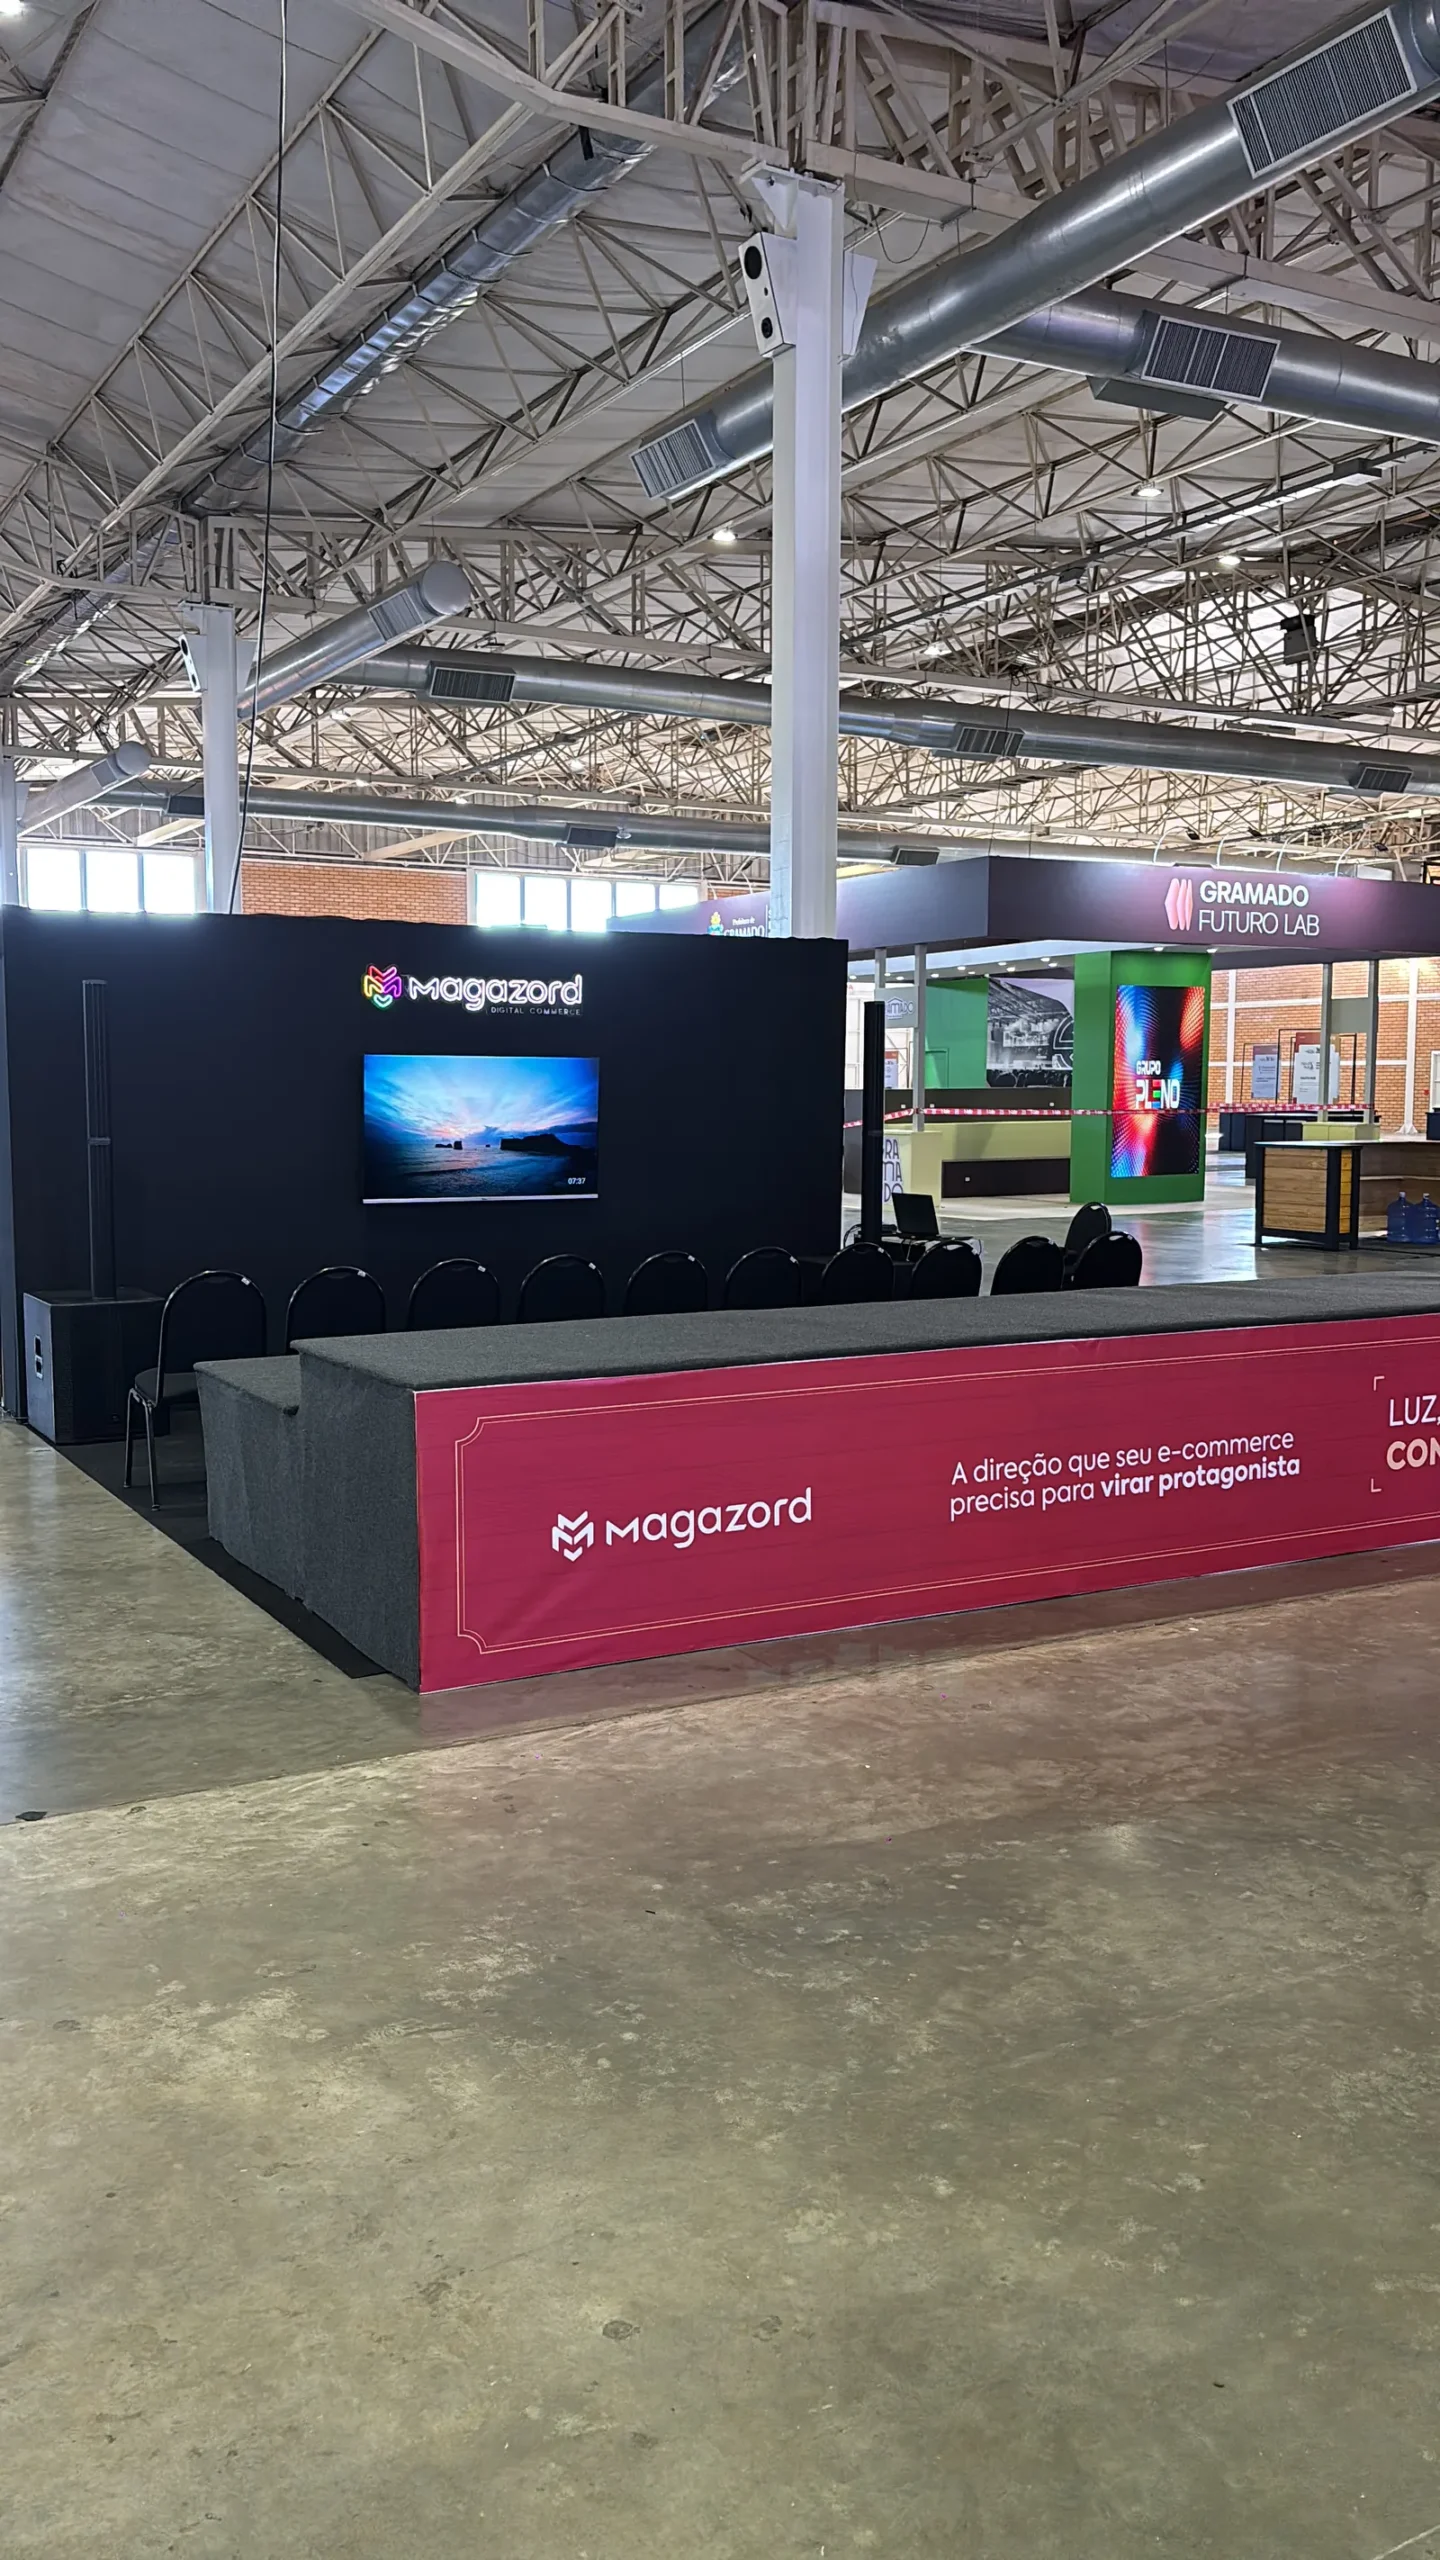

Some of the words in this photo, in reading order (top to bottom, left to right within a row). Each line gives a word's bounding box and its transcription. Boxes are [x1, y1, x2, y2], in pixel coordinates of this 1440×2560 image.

[1200, 880, 1309, 907] GRAMADO
[1199, 909, 1279, 934] FUTURO
[1284, 913, 1320, 936] LAB
[408, 974, 583, 1012] Magazord
[490, 1006, 524, 1015] DIGITAL
[529, 1007, 581, 1016] COMMERCE
[1136, 1060, 1161, 1075] GRUPO
[1135, 1079, 1181, 1109] PLENO
[567, 1177, 586, 1185] 07:37
[951, 1461, 968, 1485] A
[973, 1452, 1062, 1485] direção
[1068, 1452, 1110, 1478] que
[1116, 1447, 1152, 1468] seu
[1157, 1431, 1295, 1463] e-commerce
[950, 1487, 1035, 1522] precisa
[1041, 1481, 1095, 1511] para
[1100, 1473, 1154, 1498] virar
[1158, 1456, 1301, 1497] protagonista
[606, 1486, 812, 1549] Magazord
